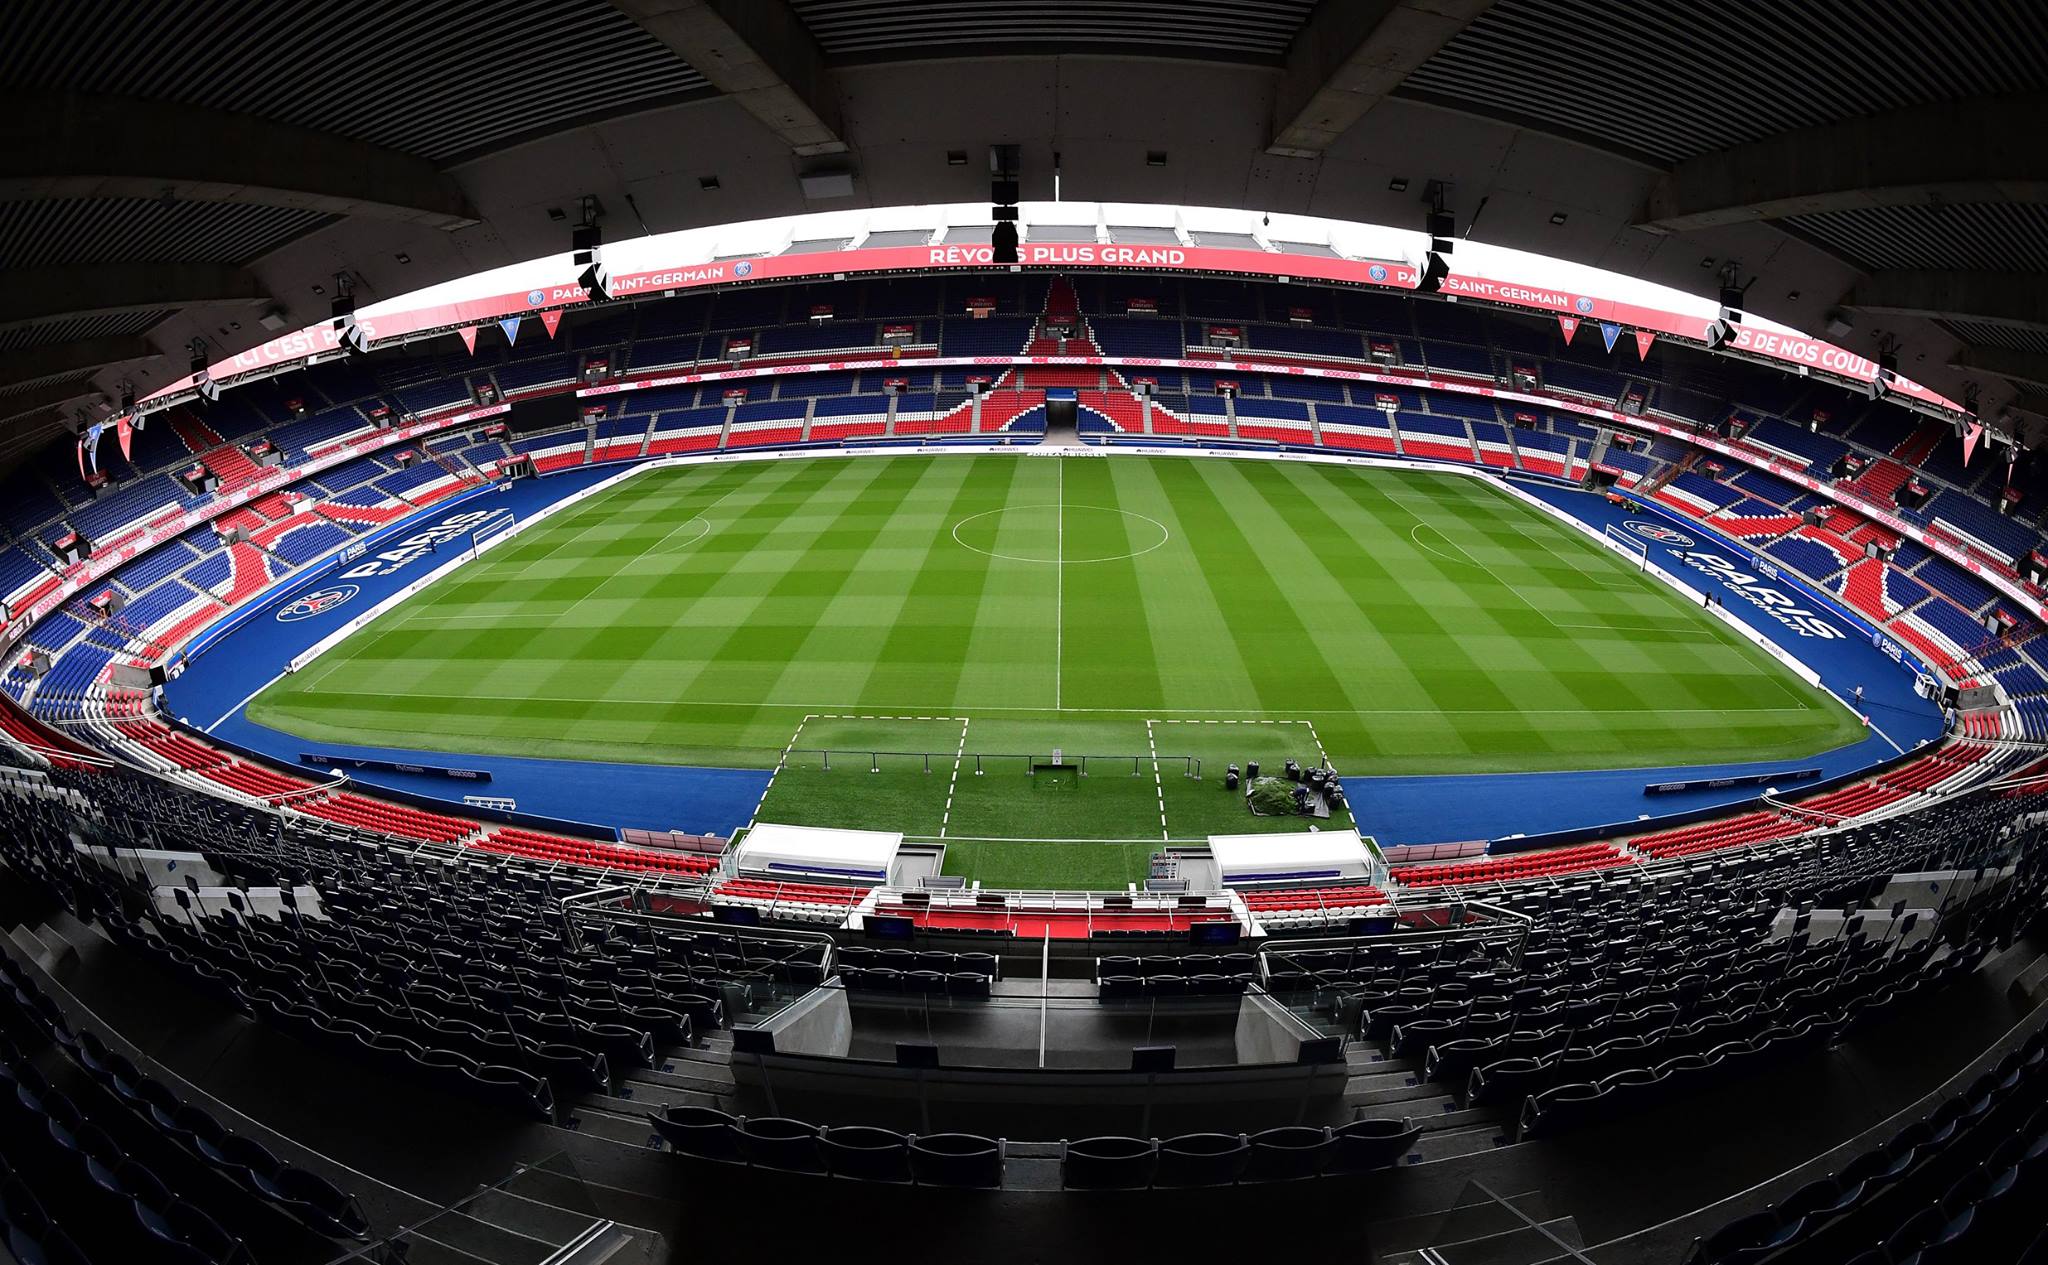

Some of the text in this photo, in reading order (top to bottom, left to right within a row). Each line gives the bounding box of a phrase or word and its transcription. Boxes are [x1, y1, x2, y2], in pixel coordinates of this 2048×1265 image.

[930, 246, 1185, 265] RÊVOS PLUS GRAND
[611, 267, 724, 292] AINT-GERMAIN
[1448, 278, 1568, 307] SAINT-GERMAIN
[263, 332, 316, 360] C'EST
[1753, 333, 1779, 353] DE
[1779, 339, 1819, 362] NOS
[338, 510, 488, 579] PARIS
[347, 541, 367, 557] PARIS
[1759, 560, 1778, 577] PARIS
[1686, 551, 1847, 640] PARIS
[1882, 638, 1903, 659] PARIS
